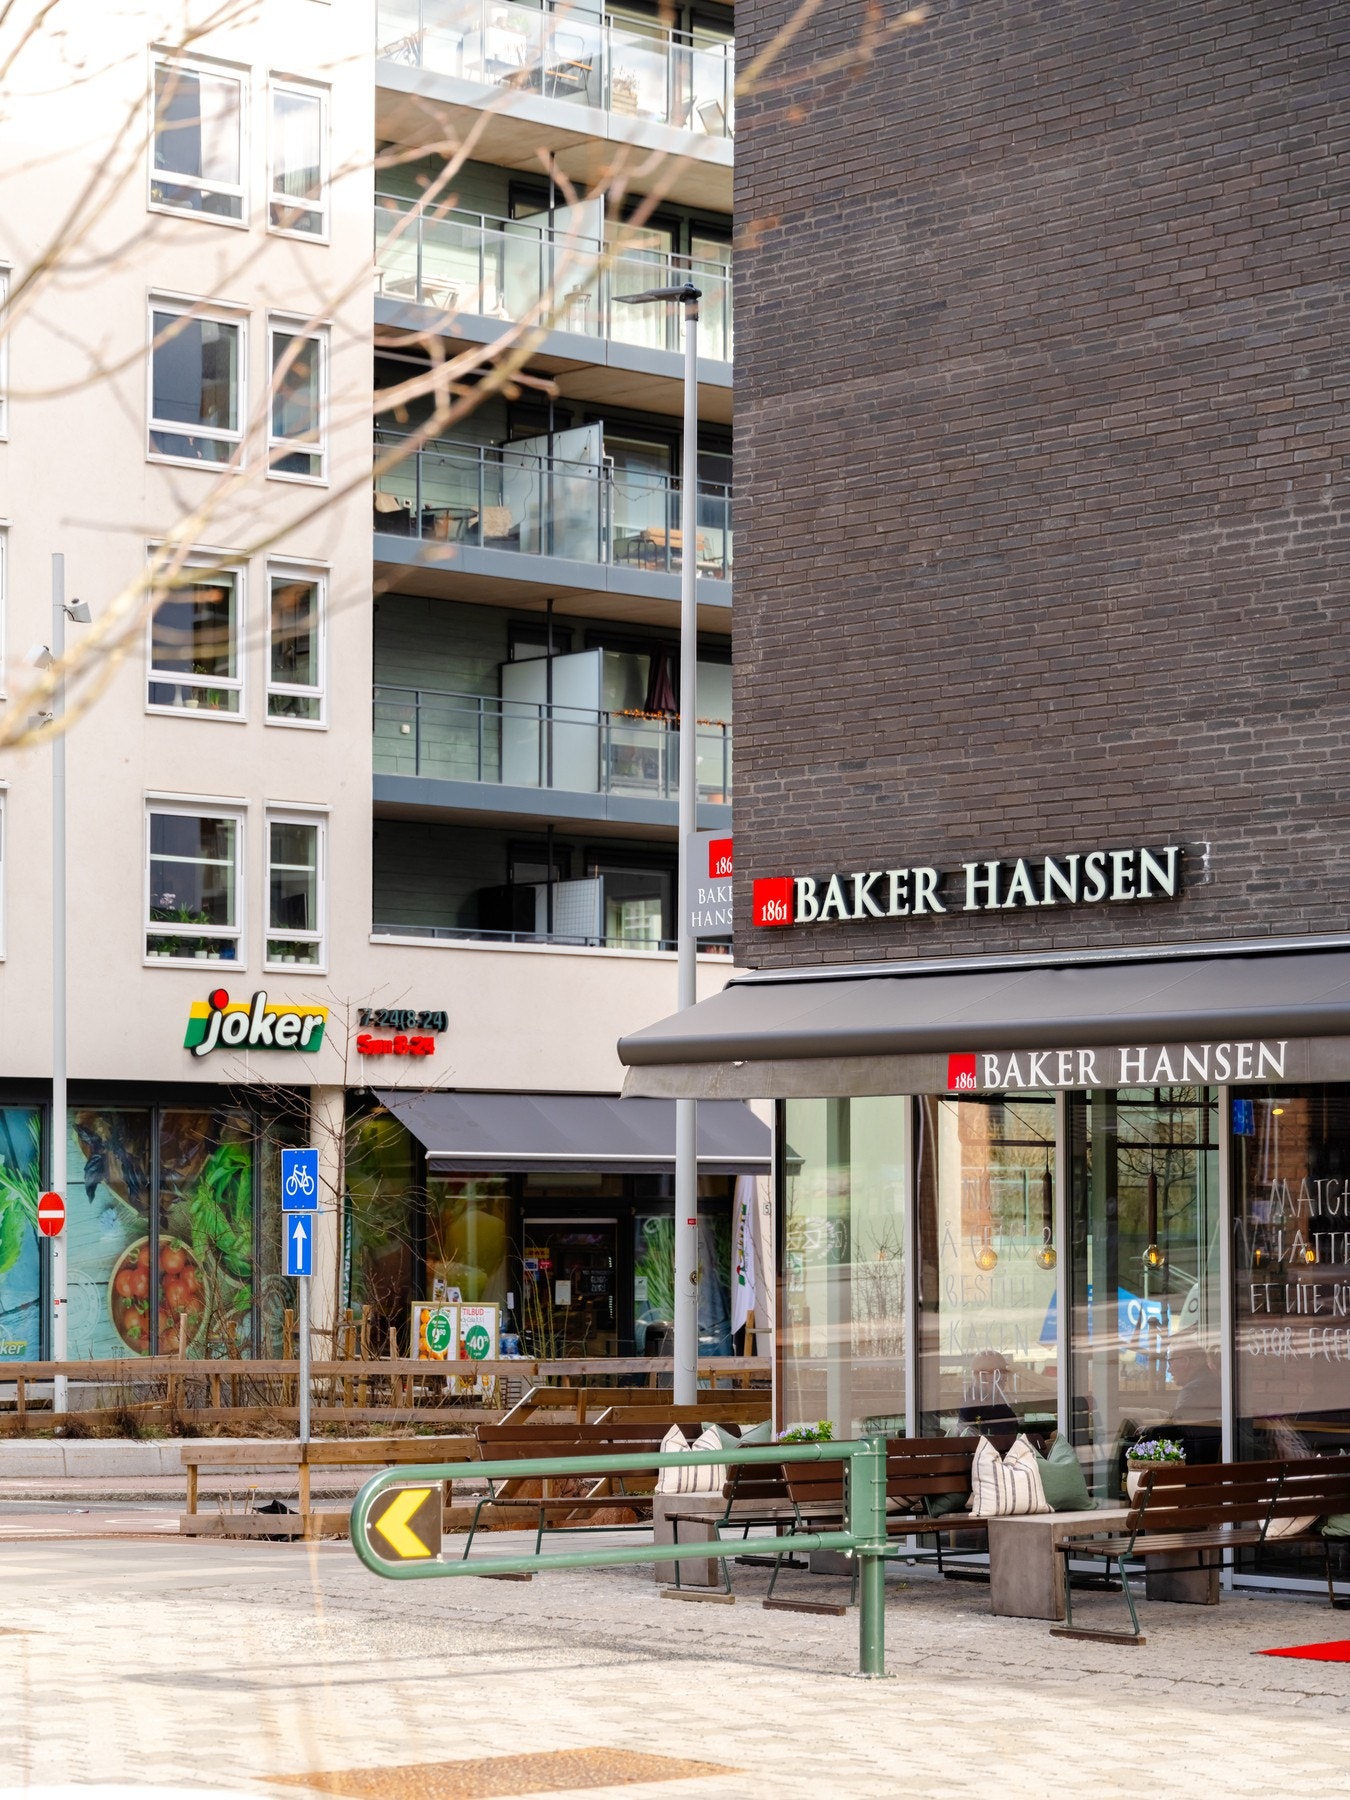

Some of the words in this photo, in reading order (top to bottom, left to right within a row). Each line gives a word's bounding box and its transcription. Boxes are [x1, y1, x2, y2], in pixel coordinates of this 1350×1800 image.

[761, 900, 788, 922] 1861
[794, 867, 947, 923] BAKER
[962, 847, 1179, 911] HANSEN
[191, 989, 325, 1057] joker
[955, 1072, 977, 1090] 1861
[981, 1049, 1101, 1089] BAKER
[1118, 1041, 1288, 1083] HANSEN
[463, 1308, 485, 1316] TILBUD
[1251, 1283, 1281, 1313] ET
[1248, 1327, 1298, 1361] STOR
